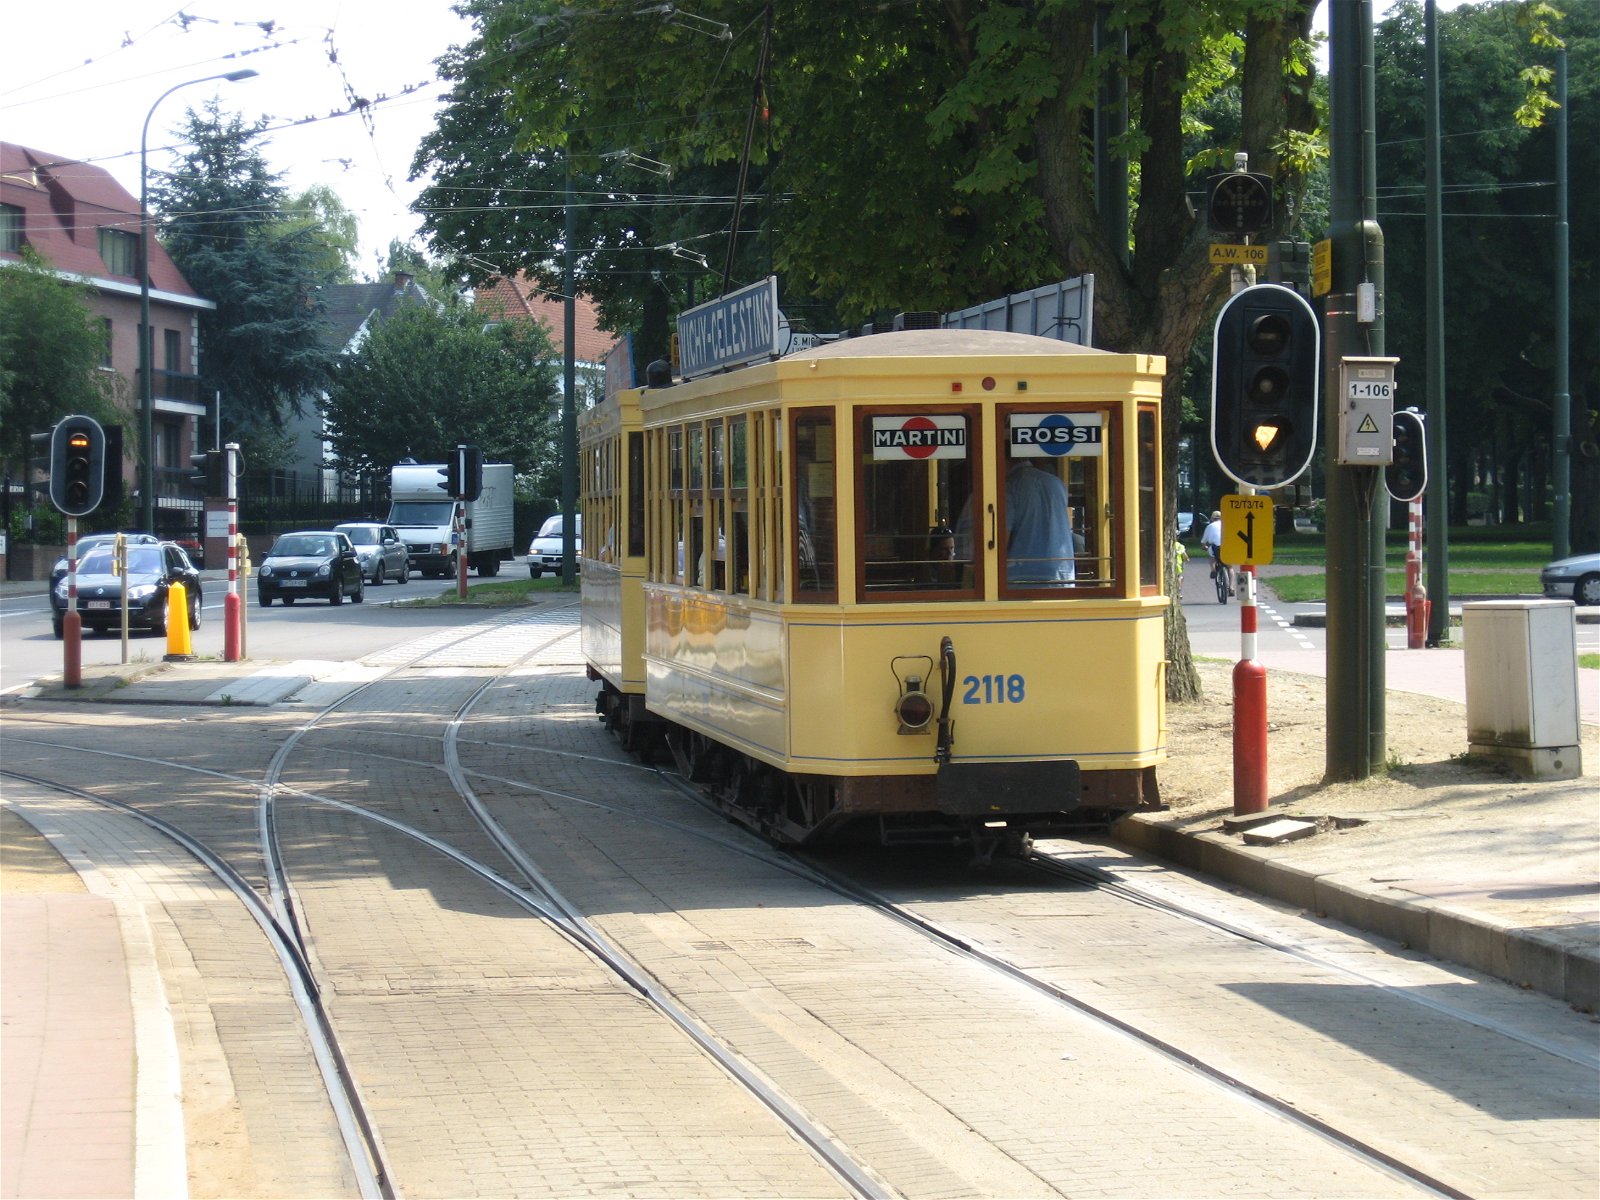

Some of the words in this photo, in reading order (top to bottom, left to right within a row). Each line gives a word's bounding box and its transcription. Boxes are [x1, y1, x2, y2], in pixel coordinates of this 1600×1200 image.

[1213, 248, 1240, 259] A.W.
[1244, 249, 1264, 259] 106
[1351, 384, 1390, 397] 1-106
[875, 429, 964, 446] MARTINI
[1017, 427, 1097, 443] ROSSI
[1229, 500, 1265, 509] T2/T3/T4
[963, 674, 1025, 705] 2118
